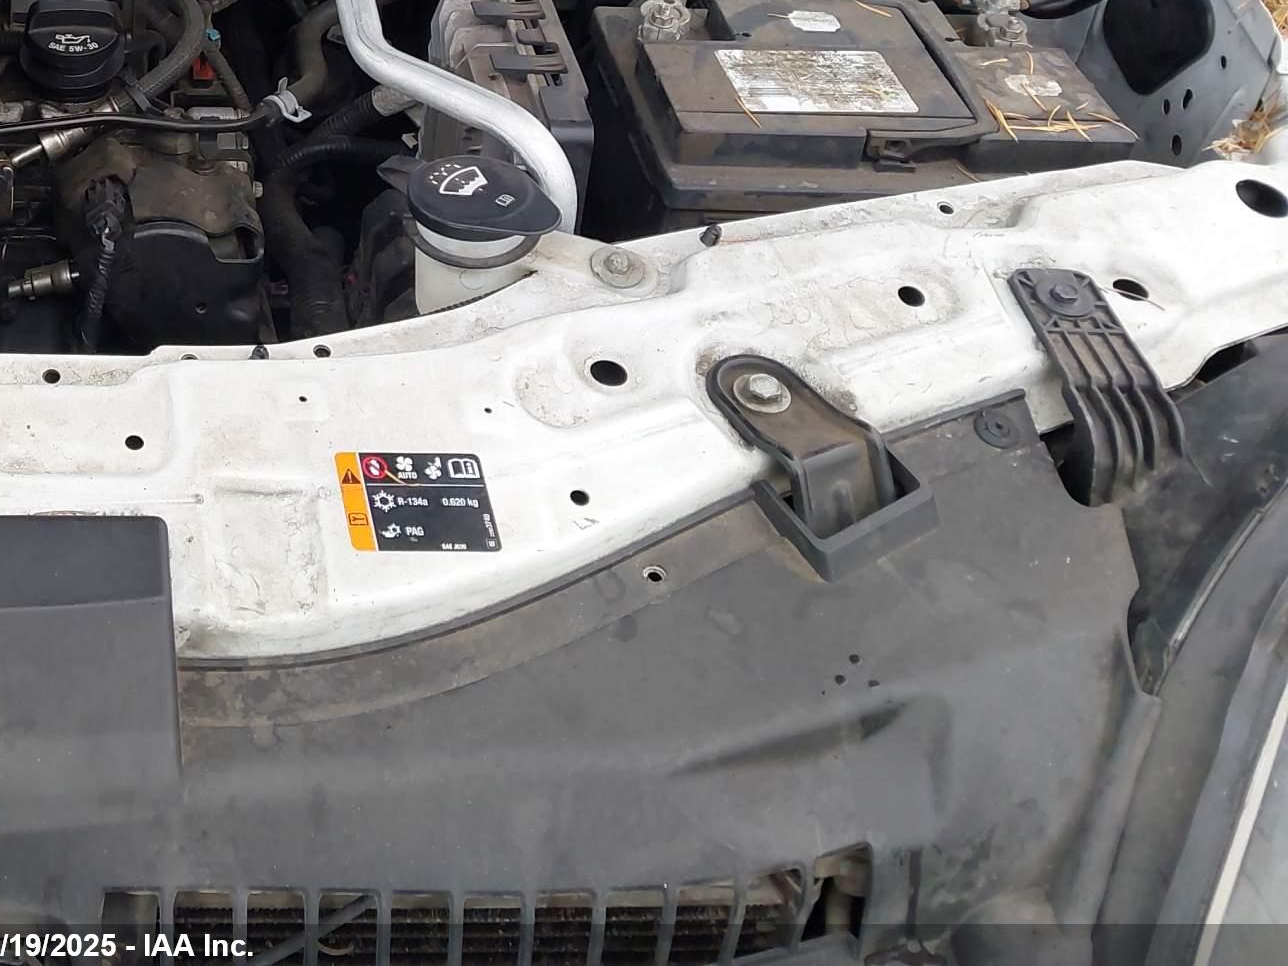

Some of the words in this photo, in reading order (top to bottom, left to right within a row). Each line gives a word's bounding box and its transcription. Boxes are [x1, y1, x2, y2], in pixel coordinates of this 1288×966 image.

[48, 42, 66, 52] SAE
[68, 42, 99, 52] 5W-30
[398, 471, 418, 479] AUTO
[397, 497, 429, 506] R-134a
[442, 497, 466, 506] 0.620
[467, 497, 479, 508] kg
[405, 526, 425, 536] PAG
